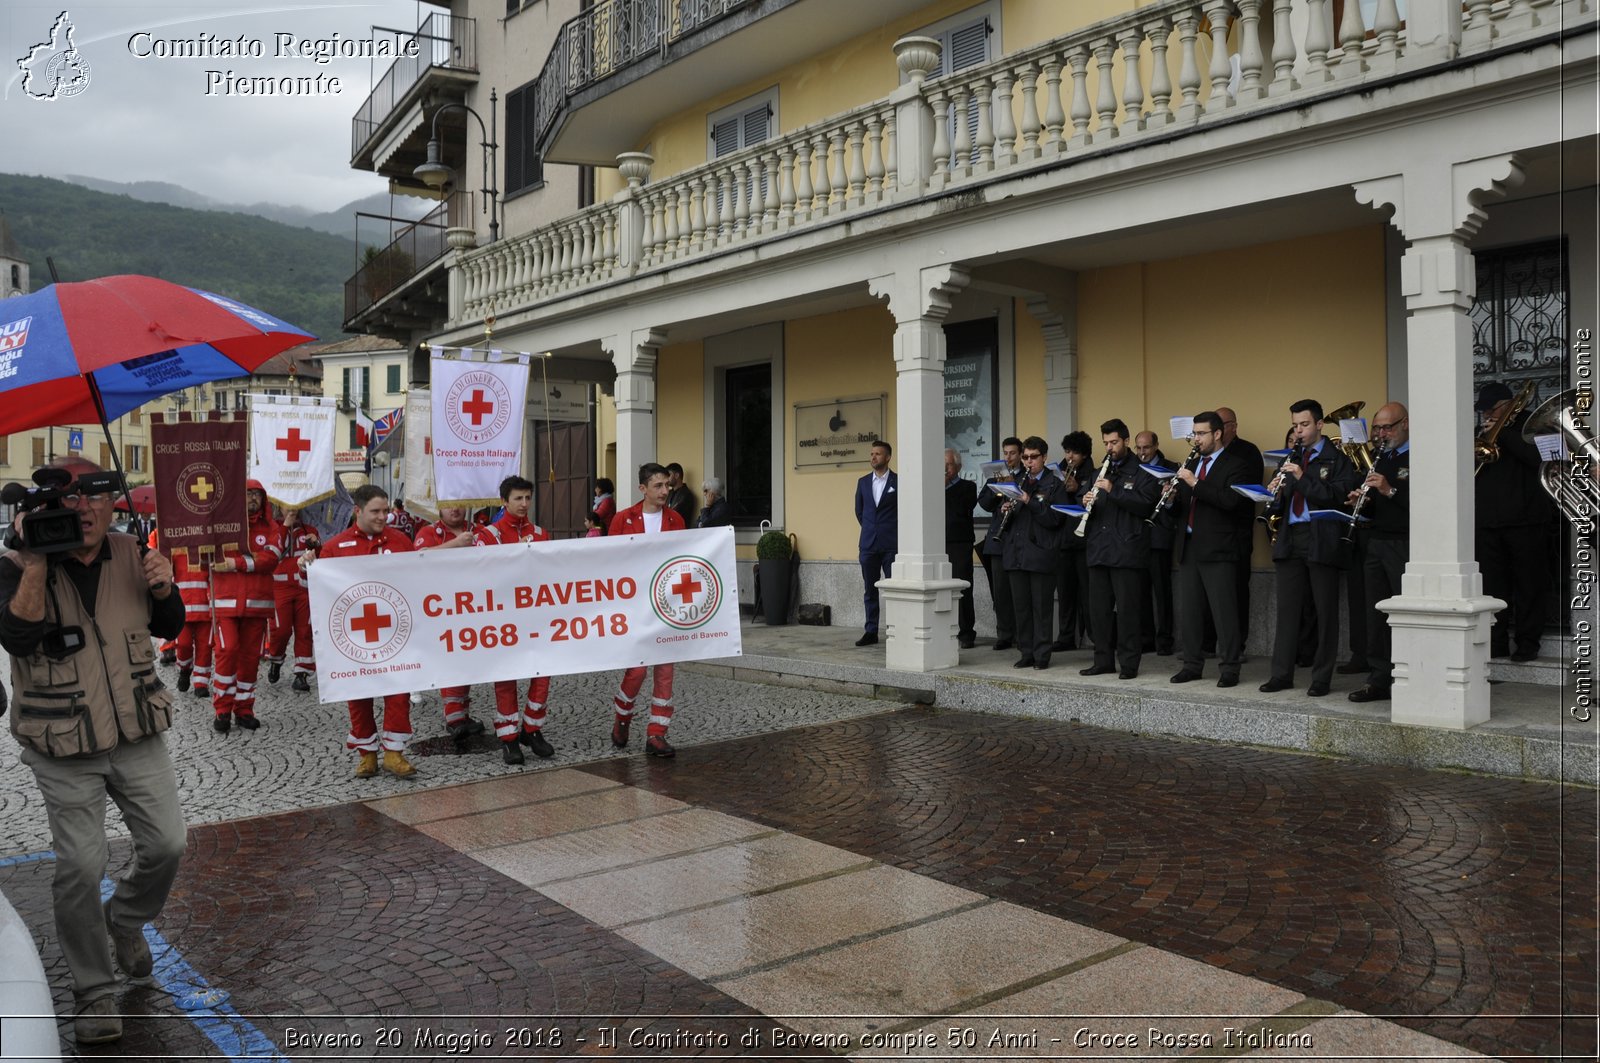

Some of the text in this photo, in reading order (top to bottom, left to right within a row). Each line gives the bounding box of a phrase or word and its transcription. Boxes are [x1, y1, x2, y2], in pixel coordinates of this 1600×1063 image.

[448, 391, 473, 440] CONVENZIONE
[464, 373, 497, 387] GINEVRA
[495, 399, 509, 431] AGOSTO
[155, 440, 240, 454] CROCE ROSSA ITALIANA
[435, 448, 458, 457] Croce
[461, 448, 485, 457] Rossa
[341, 595, 352, 607] DI
[352, 585, 393, 600] GINEVRA
[422, 576, 637, 618] C.R.I. BAVENO
[679, 604, 699, 622] 50
[333, 605, 368, 660] CONVENZIONE
[397, 609, 409, 644] AGOSTO
[439, 623, 519, 653] 1968
[550, 613, 629, 642] 2018
[656, 631, 729, 644] Comitato di Baveno
[380, 643, 397, 658] 1864
[330, 662, 421, 680] Croce Rossa Italiana
